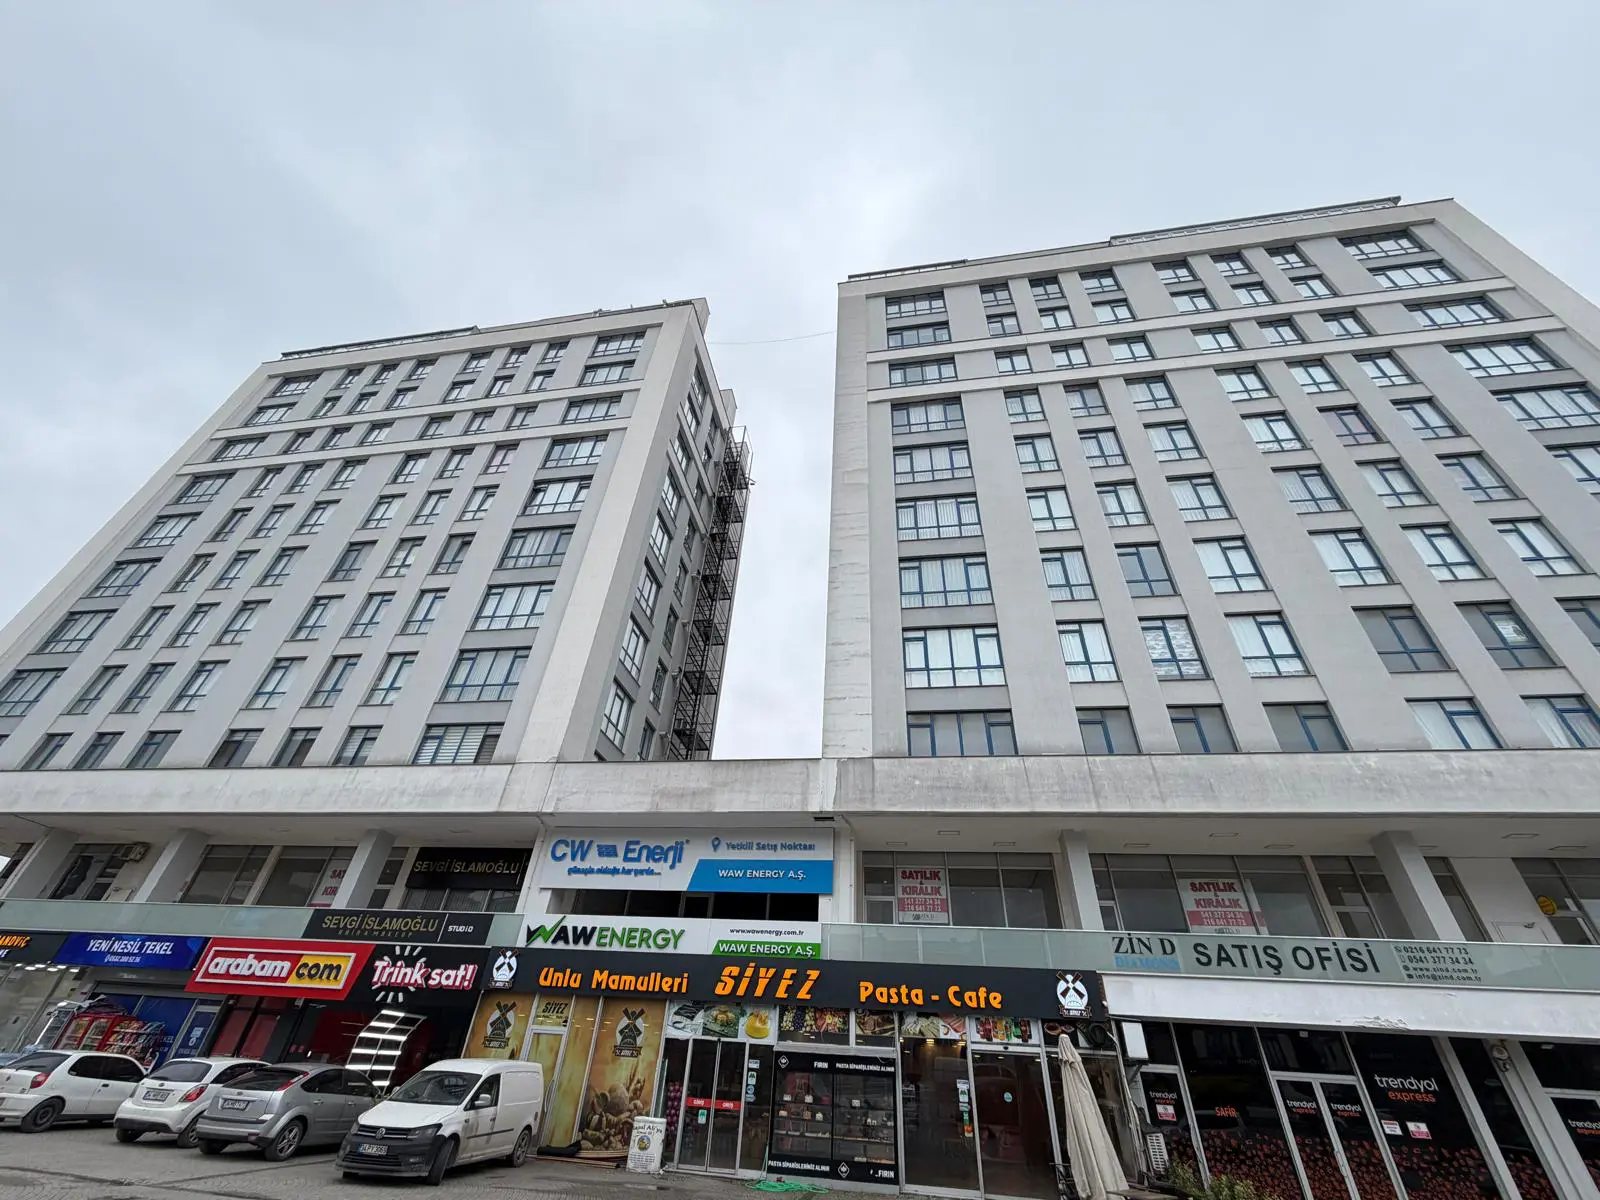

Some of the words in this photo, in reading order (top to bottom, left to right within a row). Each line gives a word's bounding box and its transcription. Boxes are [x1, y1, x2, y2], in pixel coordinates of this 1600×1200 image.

[726, 842, 753, 851] Yetkili
[551, 839, 594, 862] CW
[623, 840, 685, 870] Enerji
[450, 859, 520, 874] İSLAMOĞLU
[719, 869, 743, 878] WAW
[746, 870, 785, 878] ENERGY
[788, 870, 806, 880] A.Ş.
[900, 870, 941, 880] SATILIK
[902, 886, 942, 896] KIRALIK
[1190, 882, 1238, 892] SATILIK
[322, 914, 362, 929] SEVGİ
[362, 914, 438, 932] İSLAMOĞLU
[730, 928, 804, 936] www.wawenergy.com.tr
[87, 937, 114, 952] YENİ
[114, 938, 140, 954] NESİL
[140, 942, 174, 954] TEKEL
[719, 943, 748, 952] WAW
[750, 944, 792, 954] ENERGY
[795, 945, 816, 957] A.Ş.
[1403, 946, 1425, 954] 0216
[1426, 946, 1442, 954] 641
[1193, 942, 1283, 975] SATIŞ
[1292, 942, 1380, 973] OFİSİ
[1408, 955, 1429, 964] 0541
[1431, 956, 1446, 964] 377
[208, 954, 291, 978] arabam
[296, 962, 342, 981] com
[372, 960, 428, 988] Trink
[428, 964, 478, 990] sat!
[538, 968, 582, 988] Unlu
[591, 970, 688, 993] Mamulleri
[714, 962, 820, 1000] SİYEZ
[859, 982, 924, 1006] Pasta
[947, 986, 1002, 1009] Cafe
[1374, 1074, 1439, 1092] trendyol
[1150, 1091, 1178, 1100] trendyol
[1388, 1091, 1436, 1102] express
[1286, 1100, 1317, 1109] trendyol
[1331, 1102, 1362, 1112] trendyol
[1215, 1106, 1237, 1117] SAFİR
[878, 1170, 894, 1178] FIRIN
